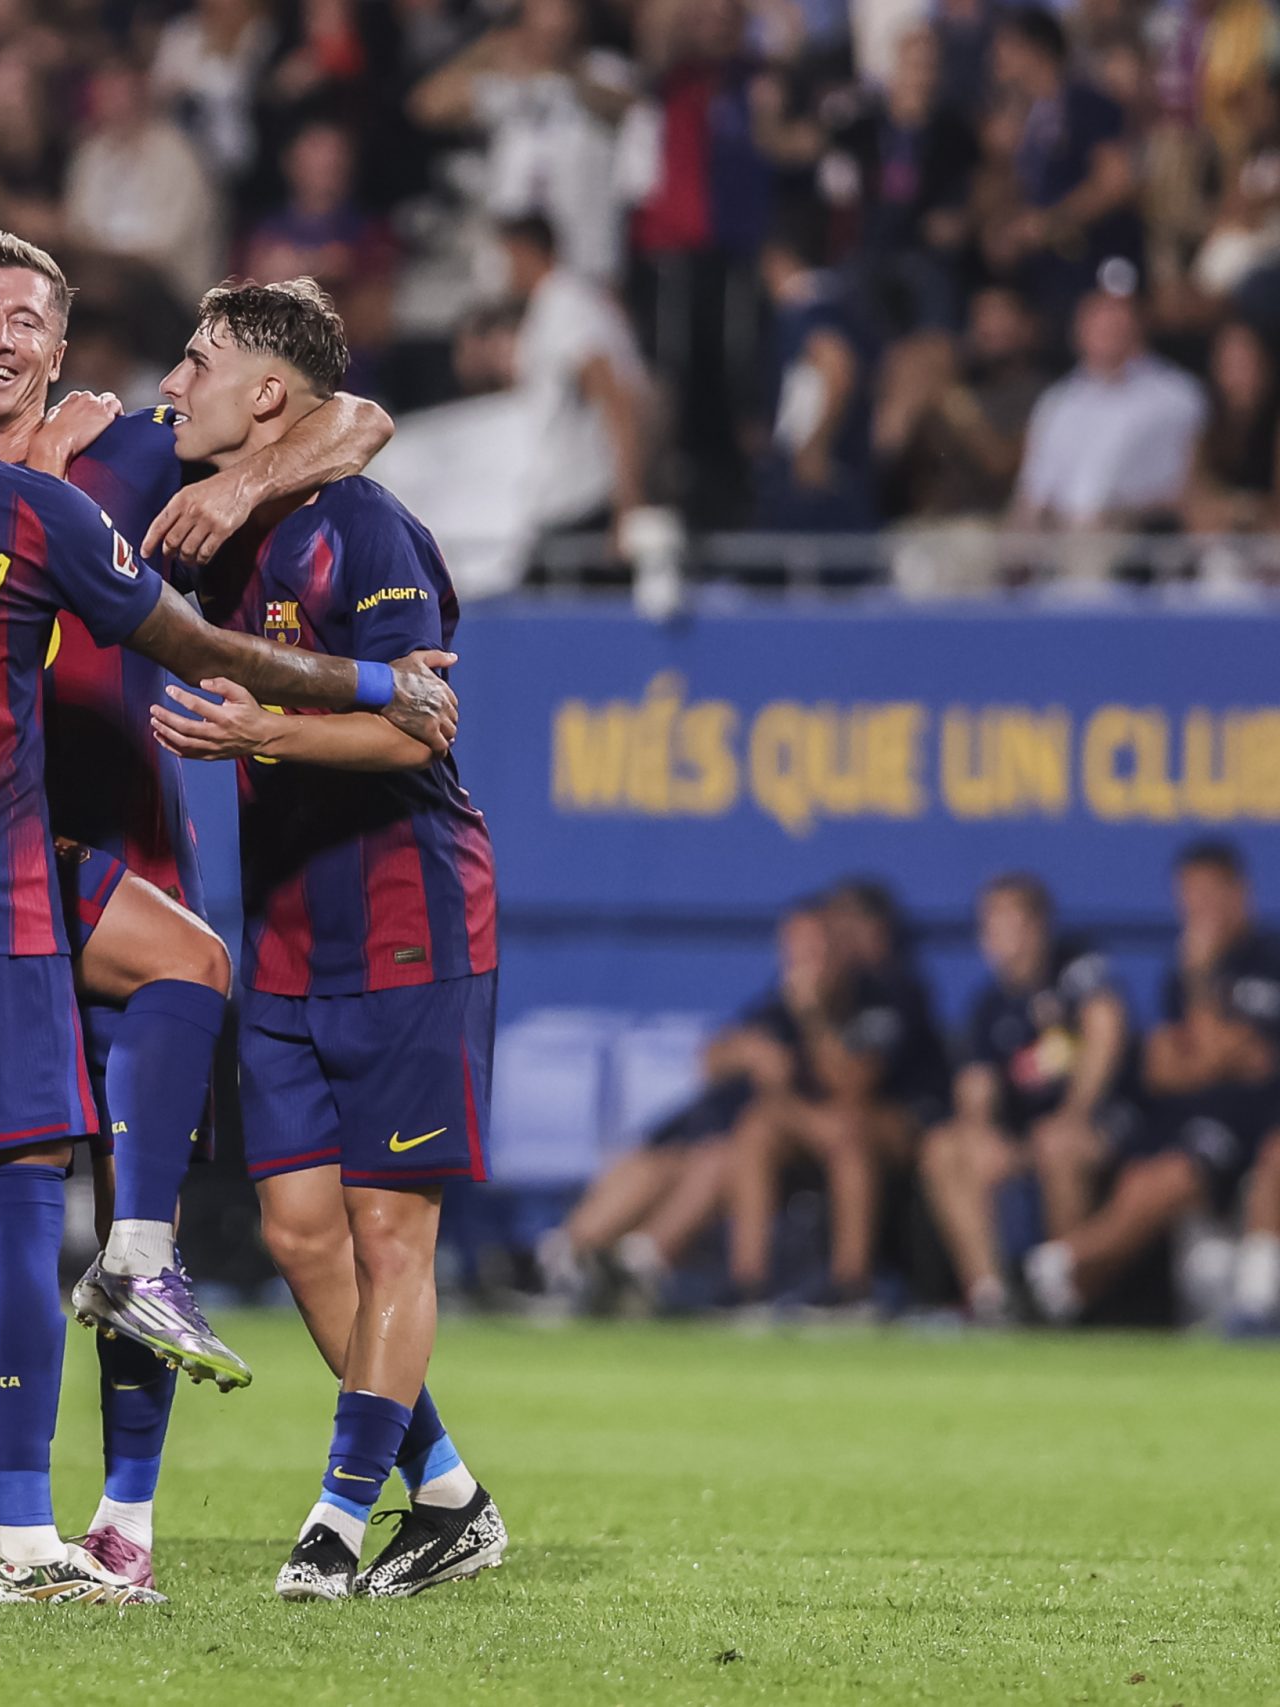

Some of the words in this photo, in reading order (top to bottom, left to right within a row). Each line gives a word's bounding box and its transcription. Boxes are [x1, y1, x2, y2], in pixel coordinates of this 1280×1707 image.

[552, 670, 738, 815] MÉS
[749, 699, 925, 838] QUE
[940, 702, 1071, 819] UN
